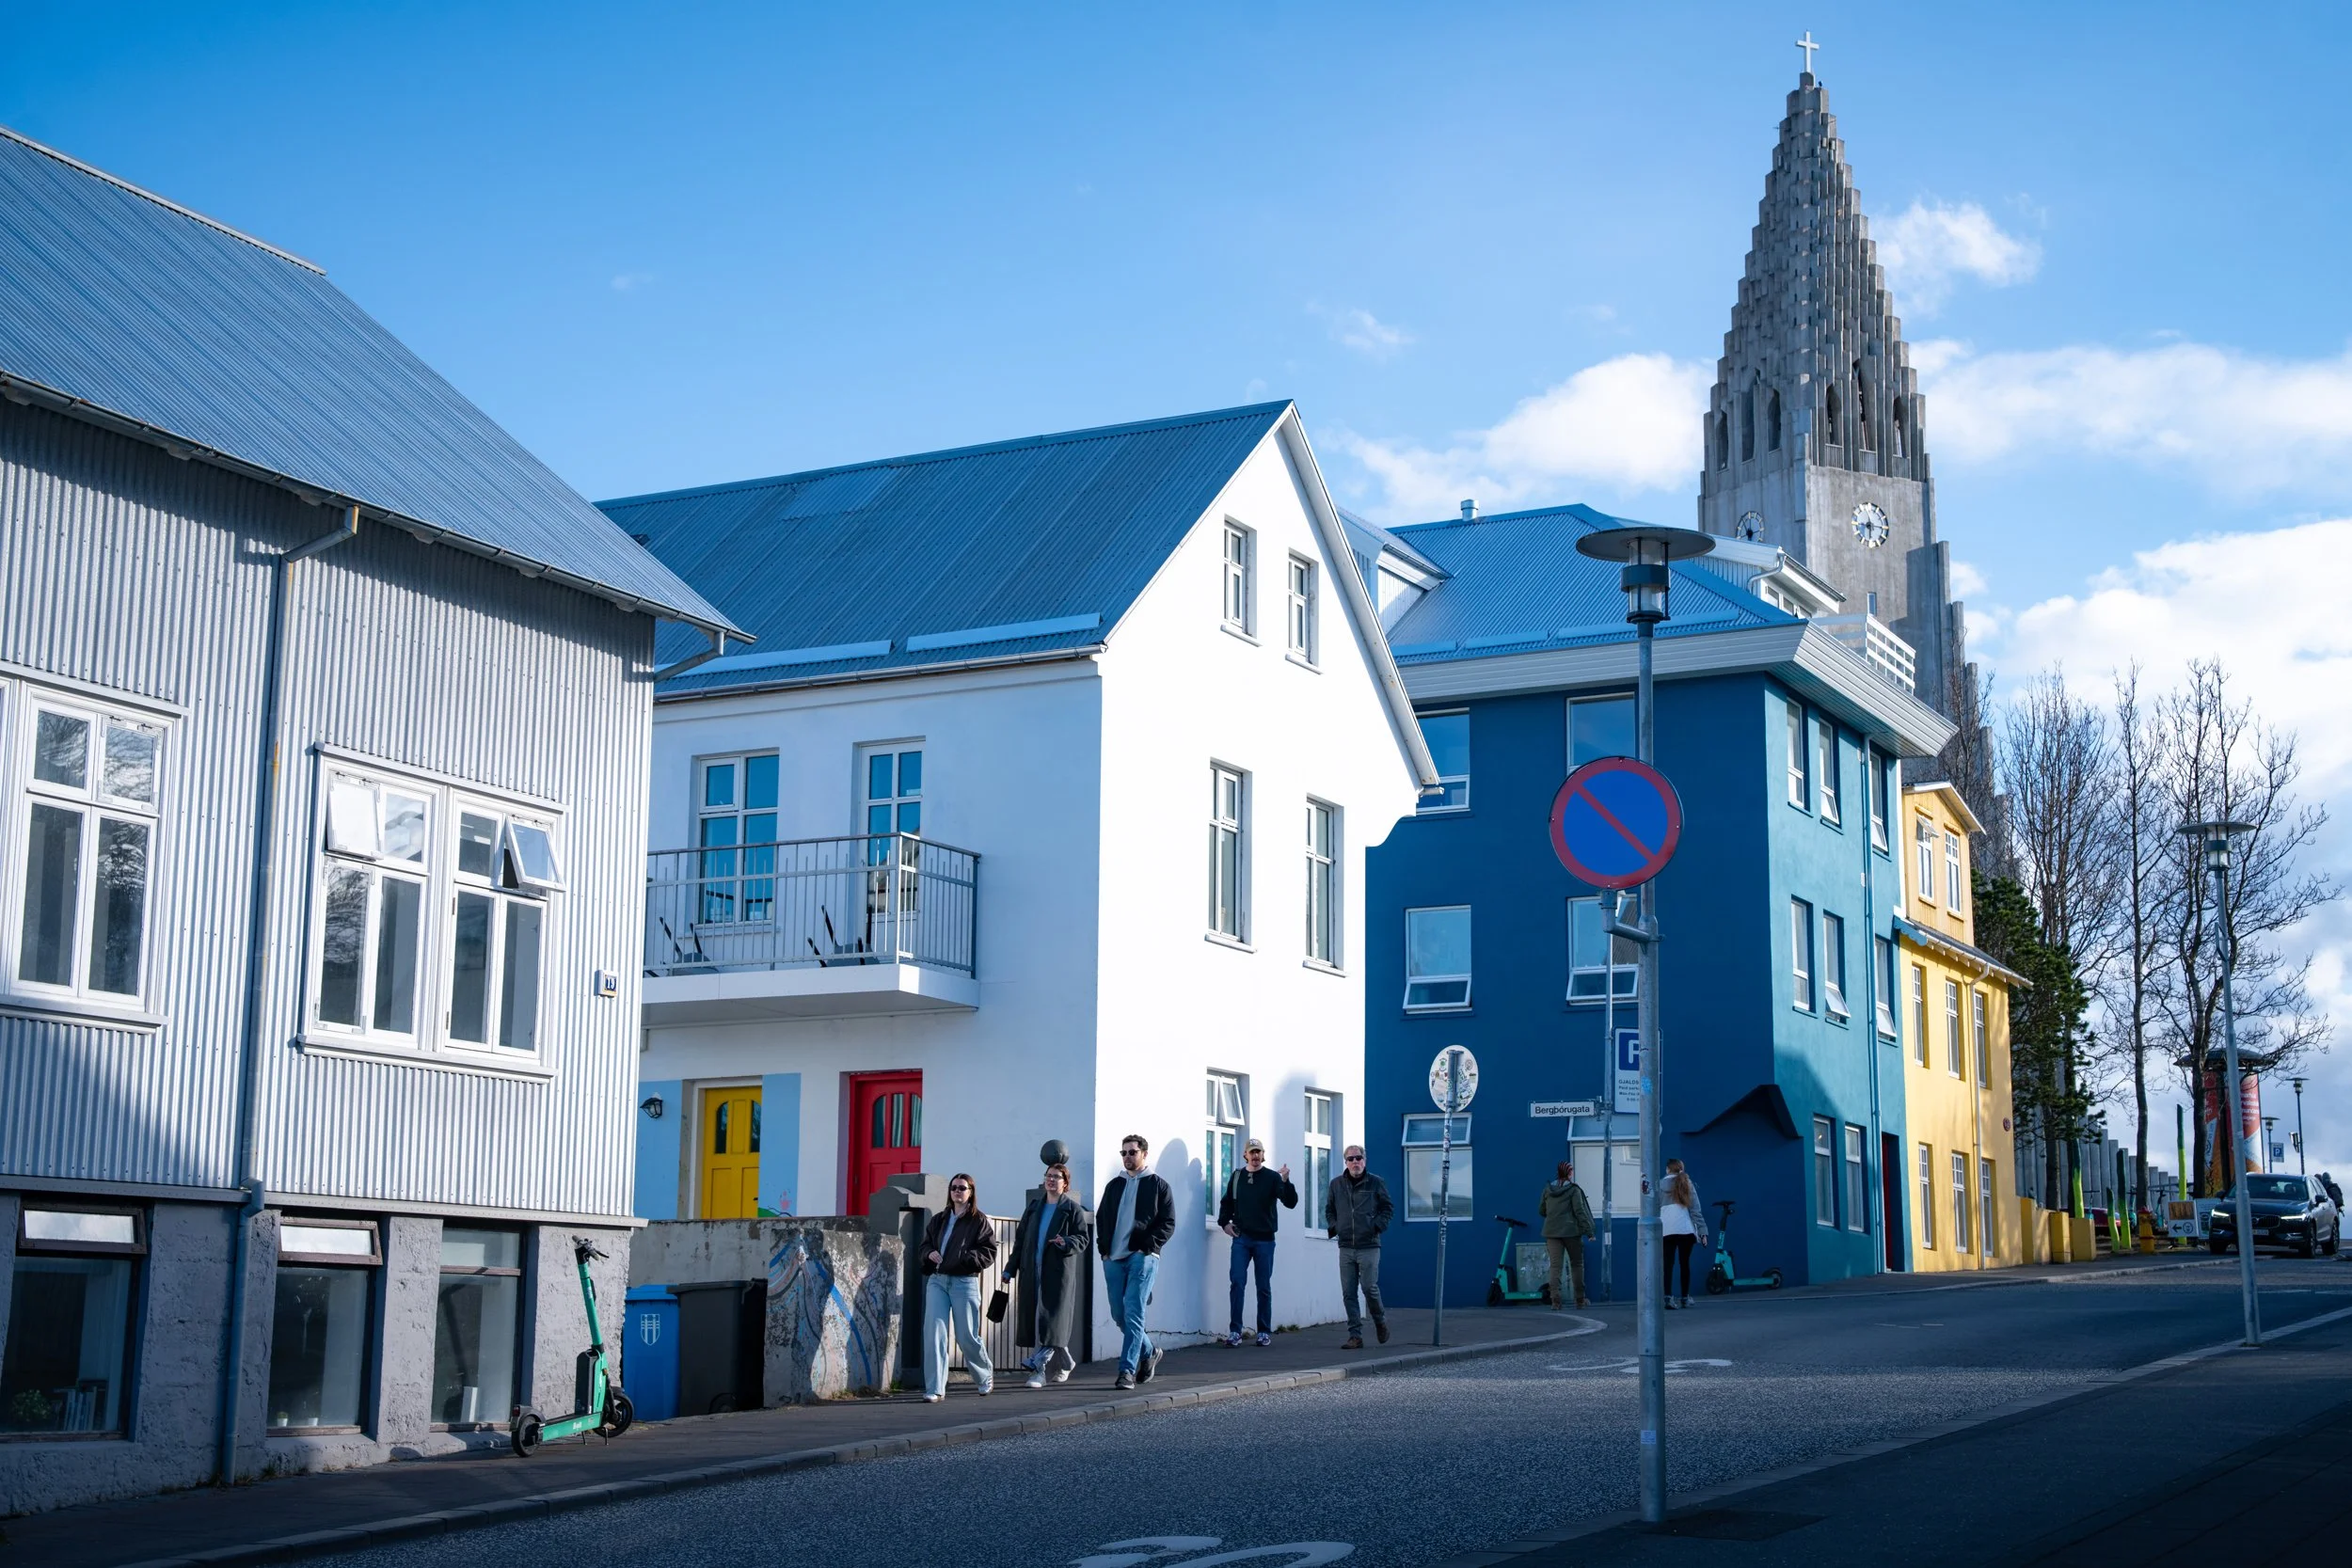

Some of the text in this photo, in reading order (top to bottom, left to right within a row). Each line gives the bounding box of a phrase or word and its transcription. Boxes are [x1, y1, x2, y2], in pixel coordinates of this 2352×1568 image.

[1629, 1039, 1639, 1064] P
[1535, 1105, 1590, 1115] Bergþórugata
[2273, 1145, 2280, 1156] P
